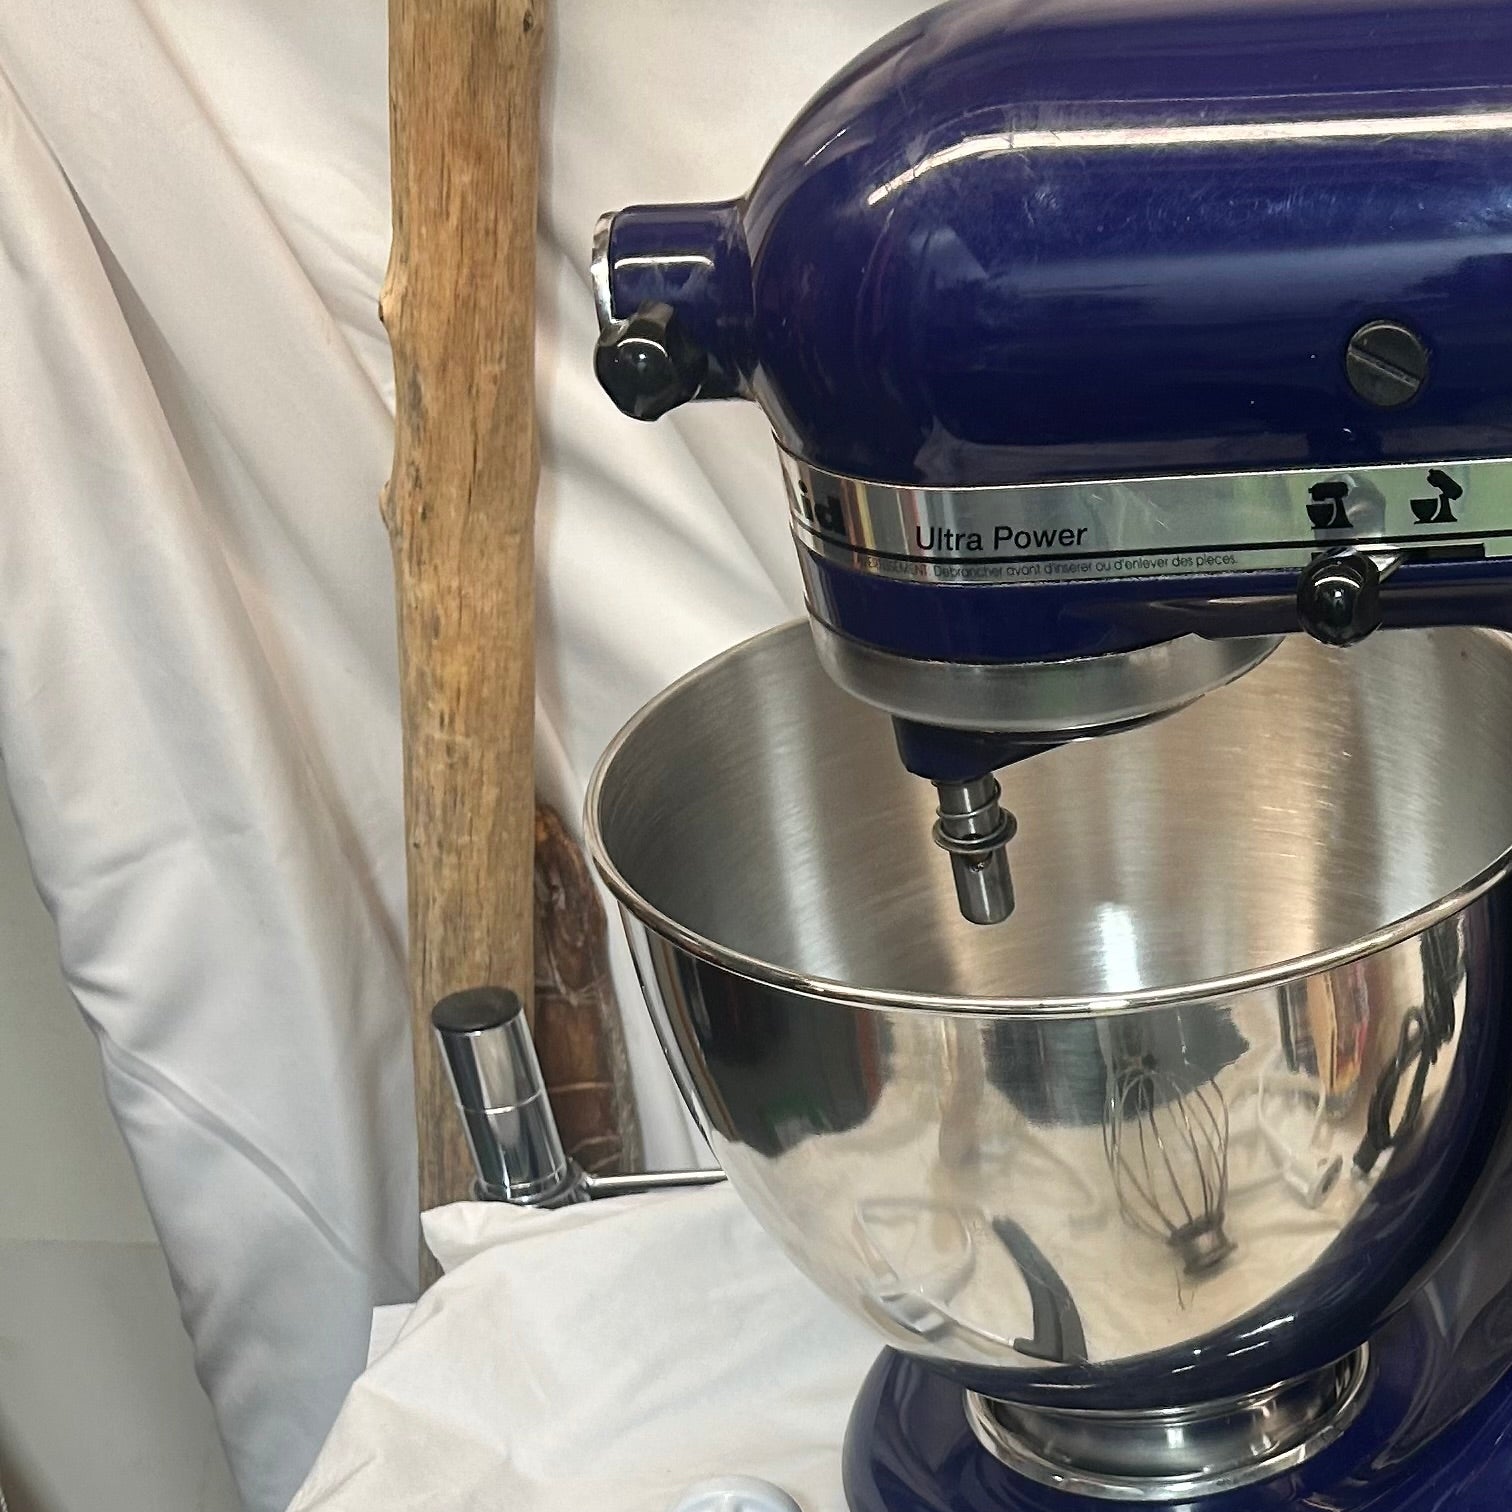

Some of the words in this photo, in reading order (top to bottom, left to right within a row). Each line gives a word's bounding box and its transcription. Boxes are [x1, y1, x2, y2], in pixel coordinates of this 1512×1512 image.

[915, 525, 983, 552] Ultra
[992, 525, 1088, 551] Power
[1095, 561, 1111, 573] ou
[1171, 555, 1193, 568] des
